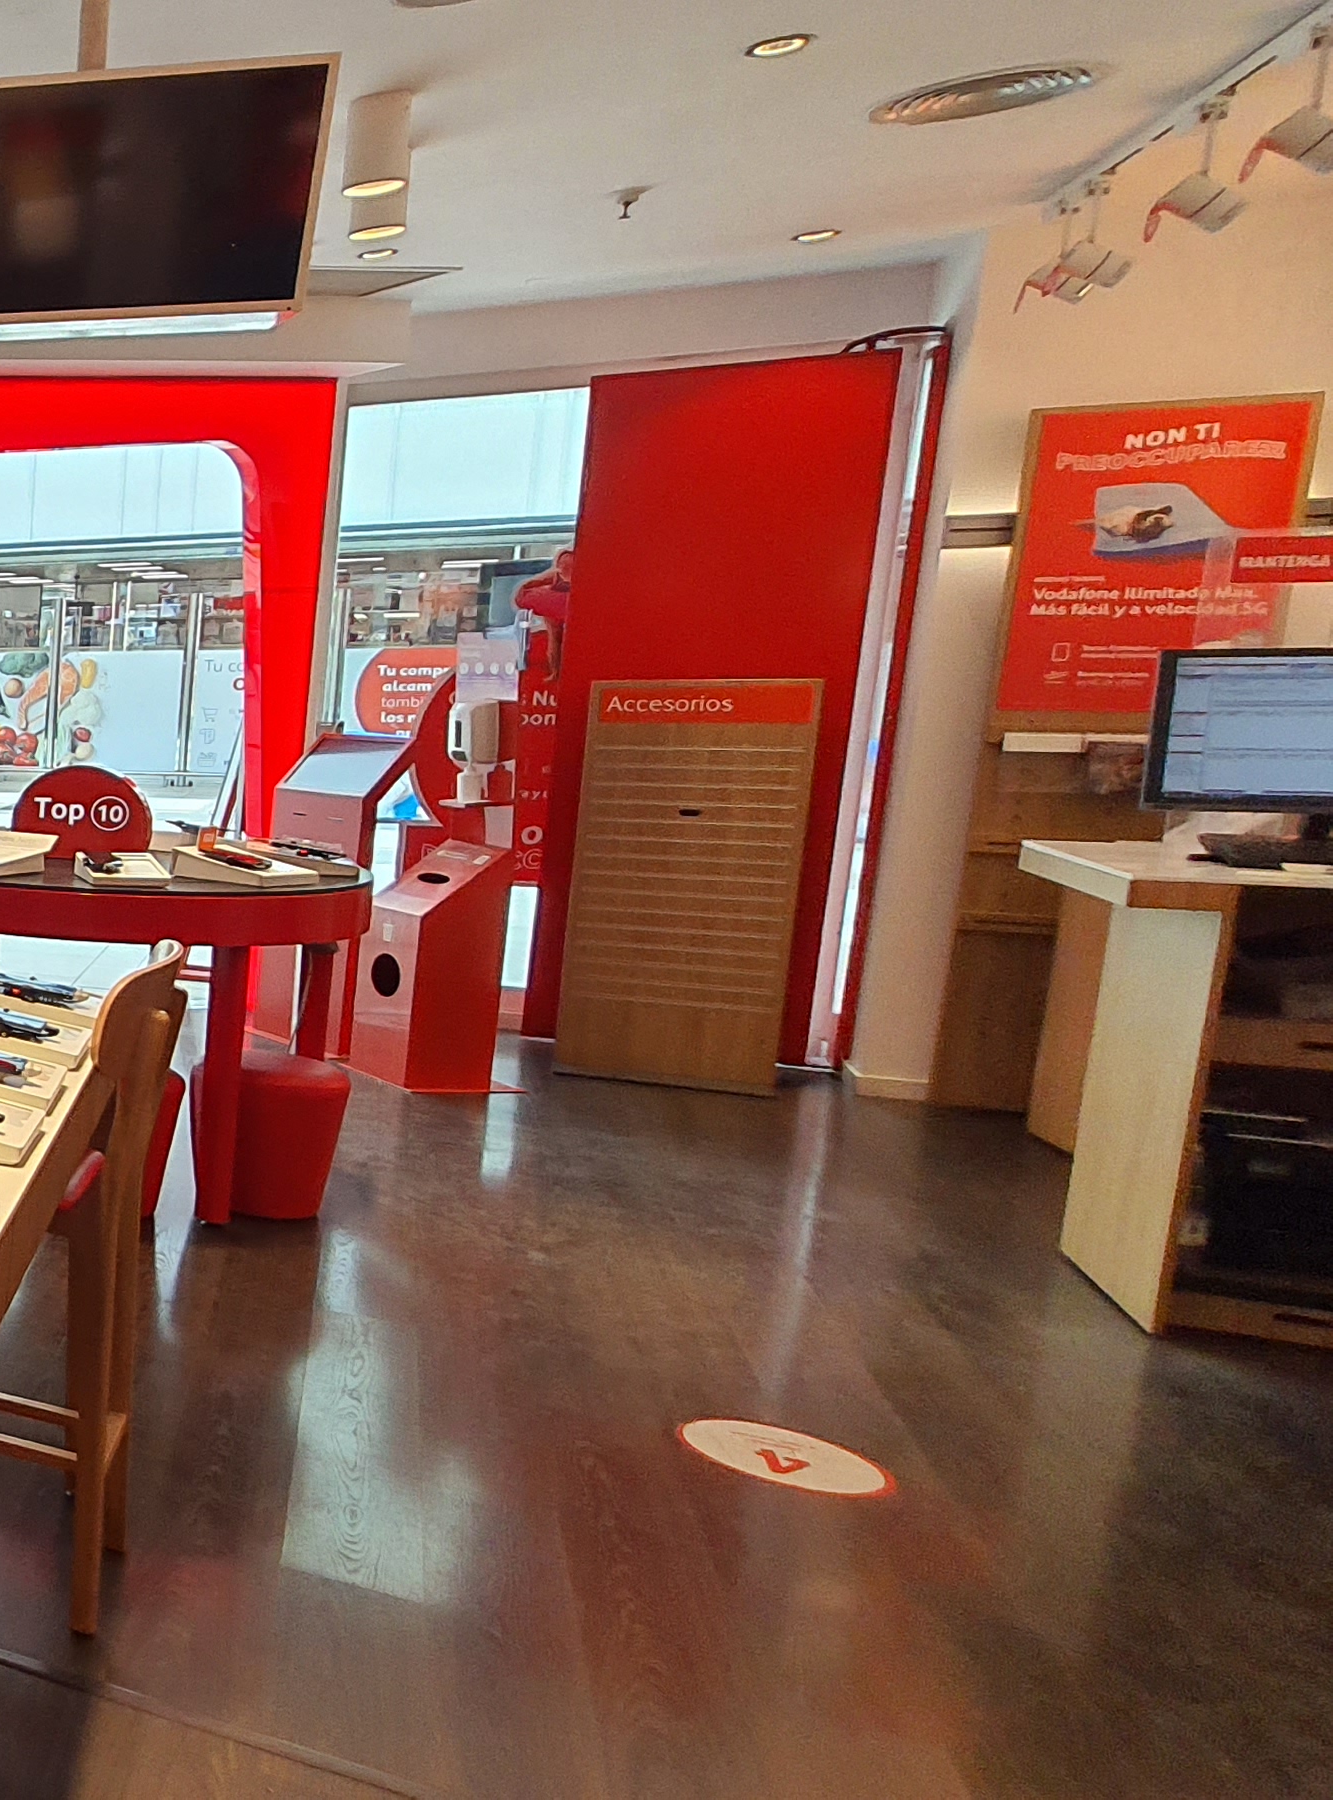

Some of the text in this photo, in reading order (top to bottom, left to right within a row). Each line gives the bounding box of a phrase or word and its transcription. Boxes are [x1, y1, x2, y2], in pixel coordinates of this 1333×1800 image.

[1123, 422, 1221, 449] NON TI
[1033, 587, 1120, 601] Vodafone
[1029, 603, 1066, 616] Más
[1071, 603, 1110, 616] fácil
[204, 659, 223, 672] Tu
[377, 664, 397, 676] Tu
[605, 694, 734, 713] Accesorios
[380, 711, 405, 723] los
[33, 796, 123, 826] Top 10
